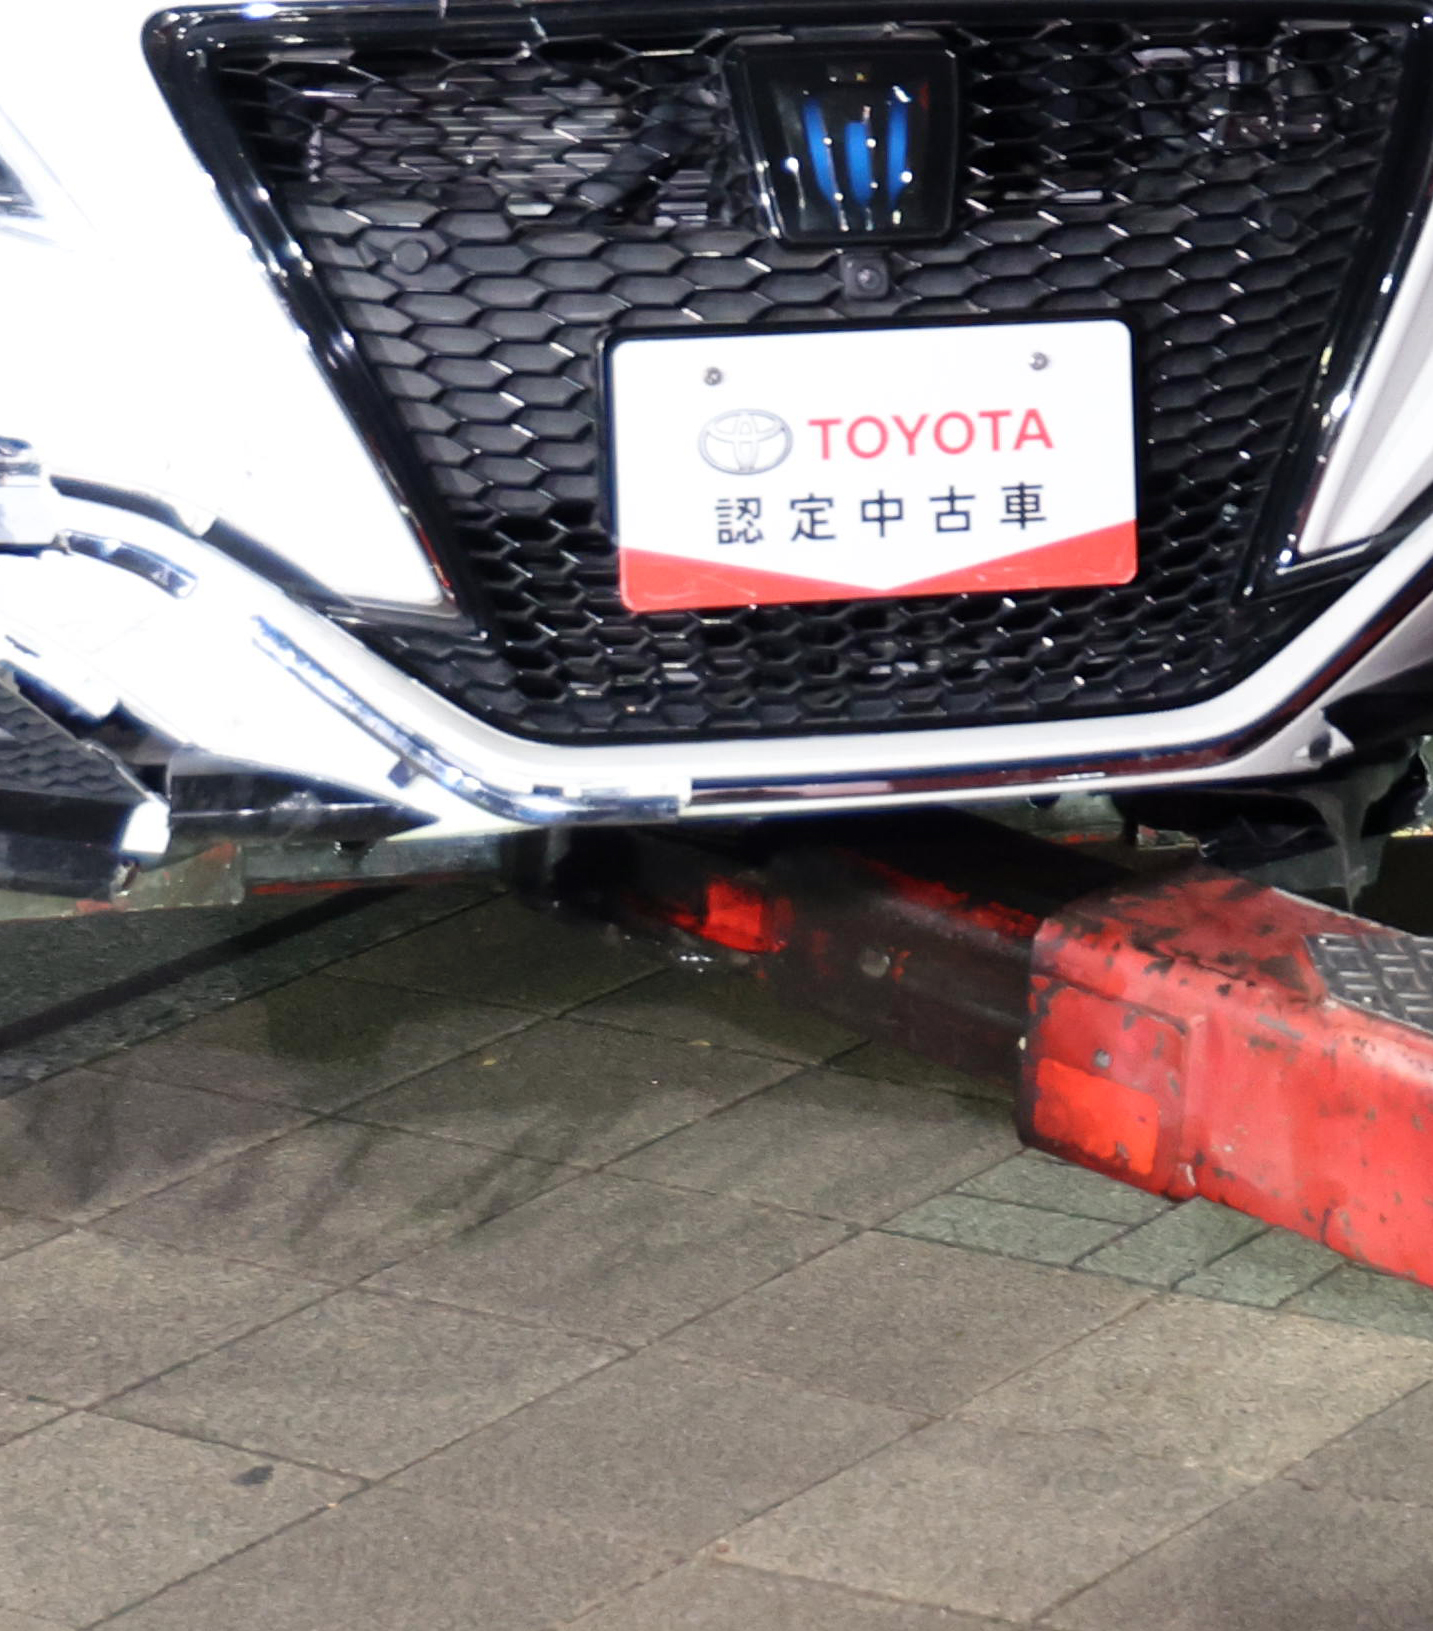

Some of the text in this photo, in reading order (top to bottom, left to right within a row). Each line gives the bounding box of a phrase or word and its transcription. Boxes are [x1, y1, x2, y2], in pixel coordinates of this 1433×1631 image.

[808, 407, 1055, 460] TOYOTA
[714, 481, 1048, 545] 認定中古車
